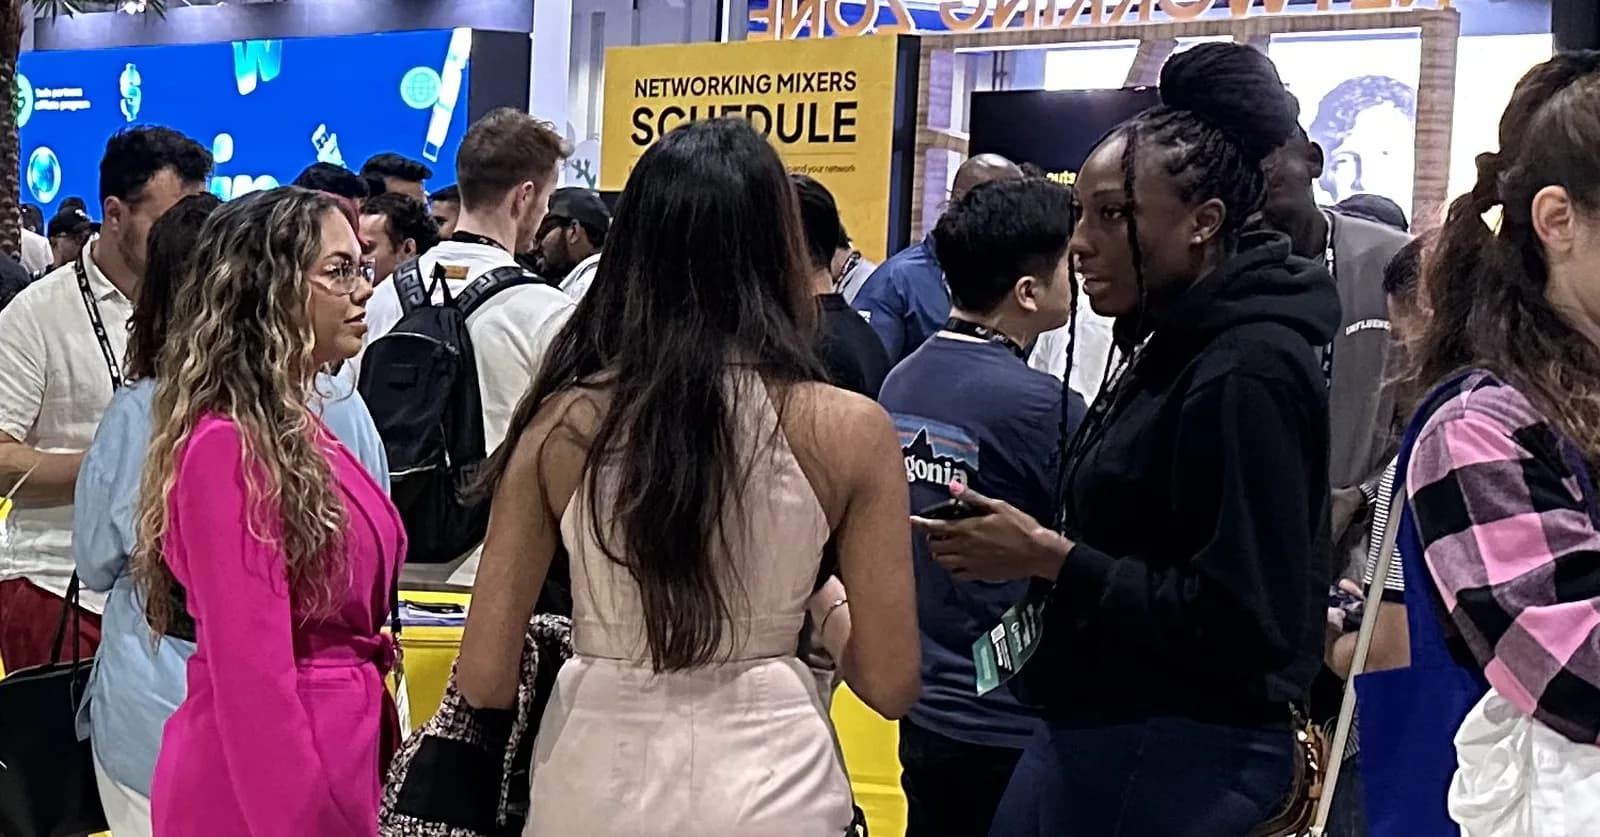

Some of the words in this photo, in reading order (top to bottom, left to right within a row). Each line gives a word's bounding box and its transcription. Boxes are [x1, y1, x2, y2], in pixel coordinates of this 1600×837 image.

[635, 73, 772, 98] NETWORKING
[777, 71, 857, 94] MIXERS
[904, 453, 968, 486] gonia
